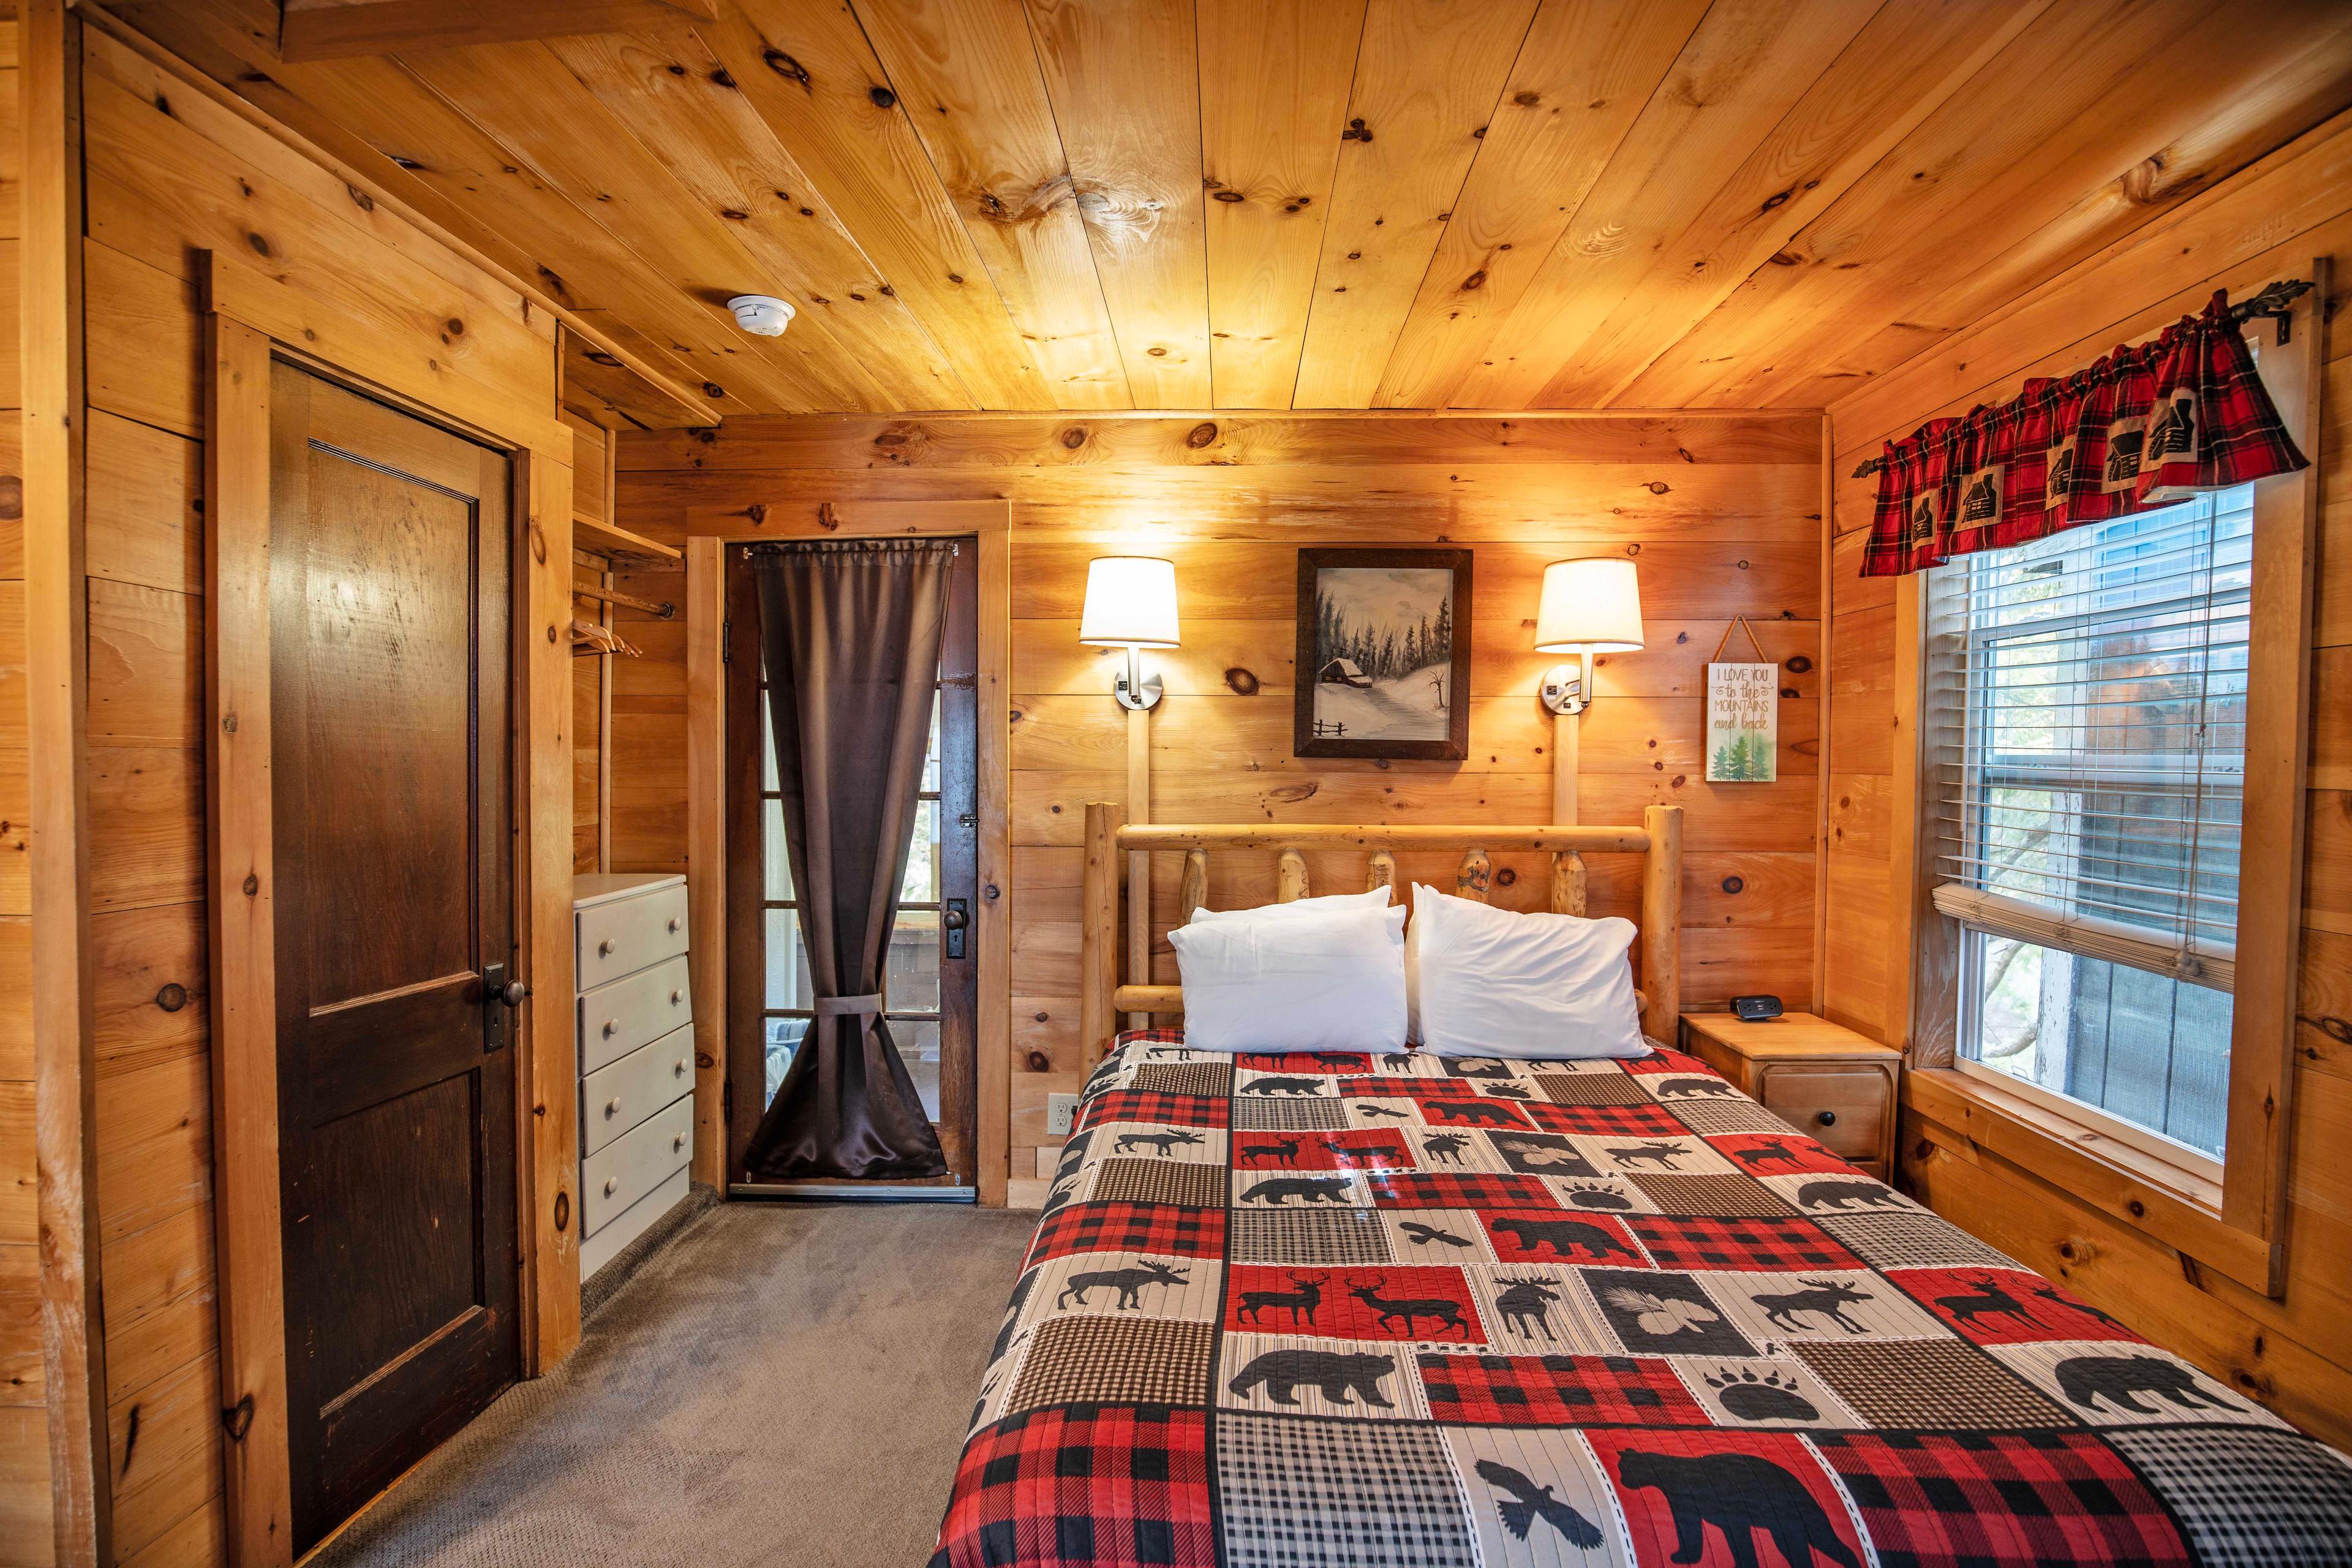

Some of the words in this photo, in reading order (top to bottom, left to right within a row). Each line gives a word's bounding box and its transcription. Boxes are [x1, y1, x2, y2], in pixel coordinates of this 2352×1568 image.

[1724, 668, 1747, 680] LOVE
[1751, 669, 1768, 682] YOU
[1725, 684, 1736, 698] to
[1740, 680, 1760, 699] the
[1715, 699, 1768, 712] MOUNTAINS
[1714, 712, 1737, 730] and
[1741, 712, 1768, 729] back
